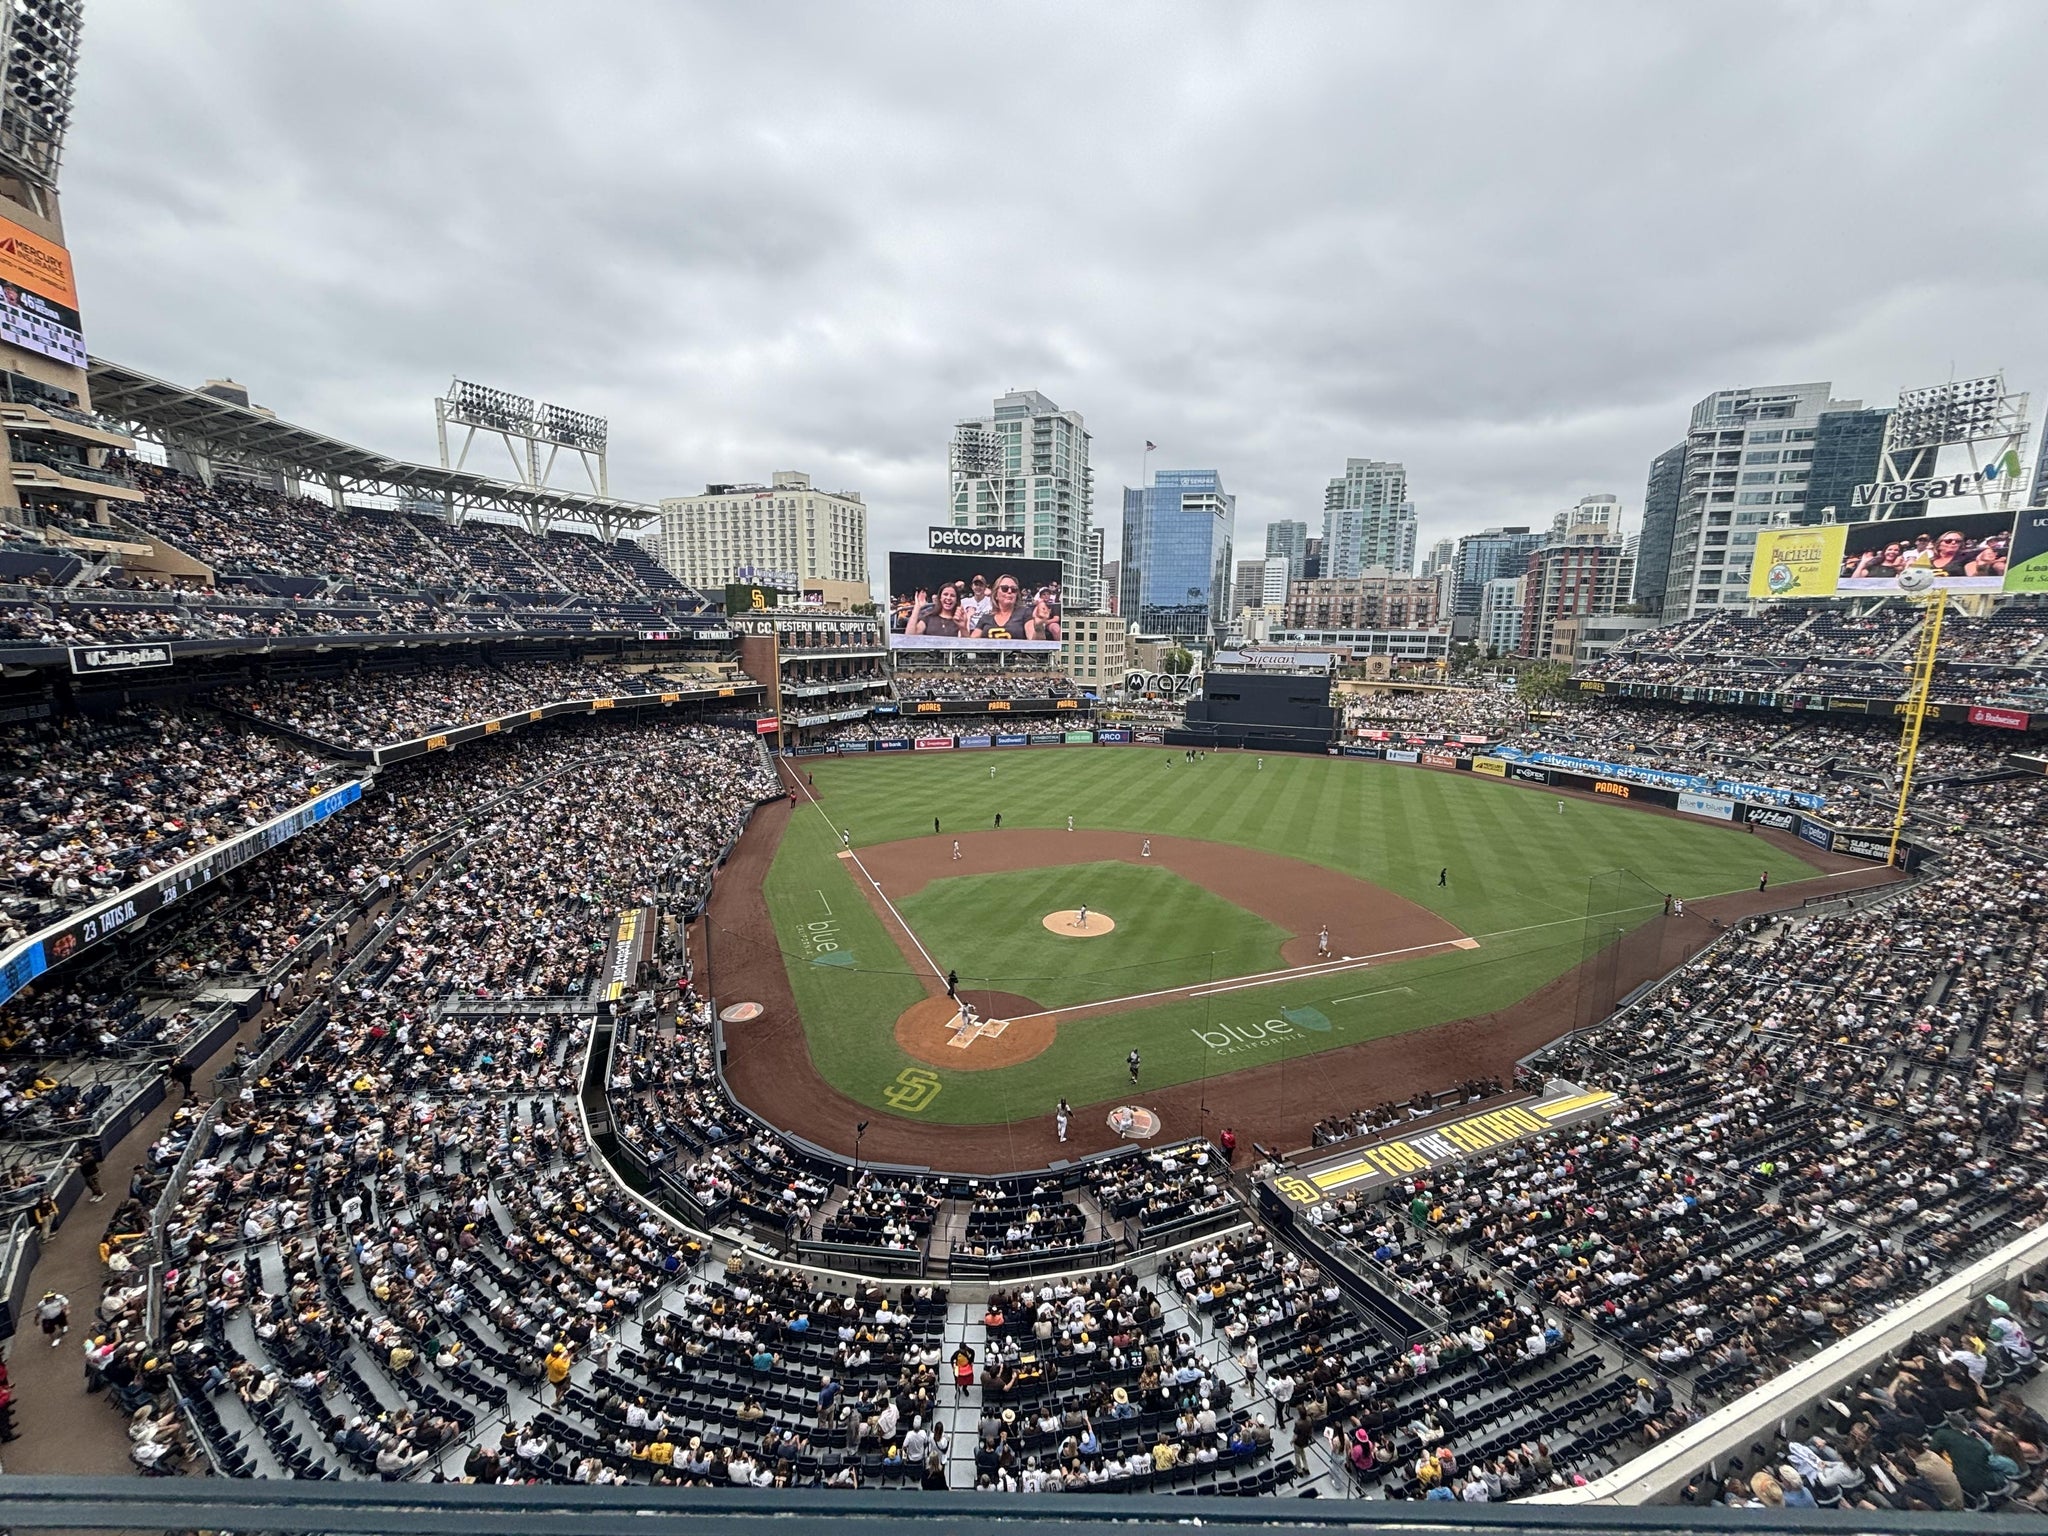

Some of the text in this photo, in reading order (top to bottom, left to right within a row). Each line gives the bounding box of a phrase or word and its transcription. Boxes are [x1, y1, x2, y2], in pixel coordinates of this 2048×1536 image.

[15, 239, 63, 268] MERCURY
[17, 251, 66, 279] INSURANCE
[20, 292, 36, 310] 46
[931, 529, 1023, 551] petco park
[776, 621, 878, 633] WESTERN METAL SUPPLY CO.
[1238, 648, 1295, 668] Sycuan
[1147, 674, 1203, 693] razr
[1580, 681, 1605, 692] PADRES
[918, 702, 941, 713] PADRES
[988, 701, 1011, 711] PADRES
[1057, 700, 1078, 709] PADRES
[1894, 703, 1940, 718] PADES
[1985, 712, 2021, 726] Budweiser
[1100, 733, 1121, 741] ARCO
[1595, 782, 1630, 798] PADRES
[324, 793, 344, 814] COX
[1808, 826, 1828, 841] petco
[1849, 846, 1872, 857] CHEESE
[1850, 839, 1870, 850] SLAP
[203, 868, 211, 882] 16
[83, 920, 98, 943] 23
[99, 905, 125, 934] TATIS
[807, 920, 841, 952] blue
[1190, 1019, 1294, 1048] blue
[1217, 1033, 1306, 1056] CALIFORNIA
[1364, 1105, 1553, 1177] FOR THE FAITHFUL
[1131, 1357, 1143, 1366] 23
[1029, 1482, 1035, 1493] 3
